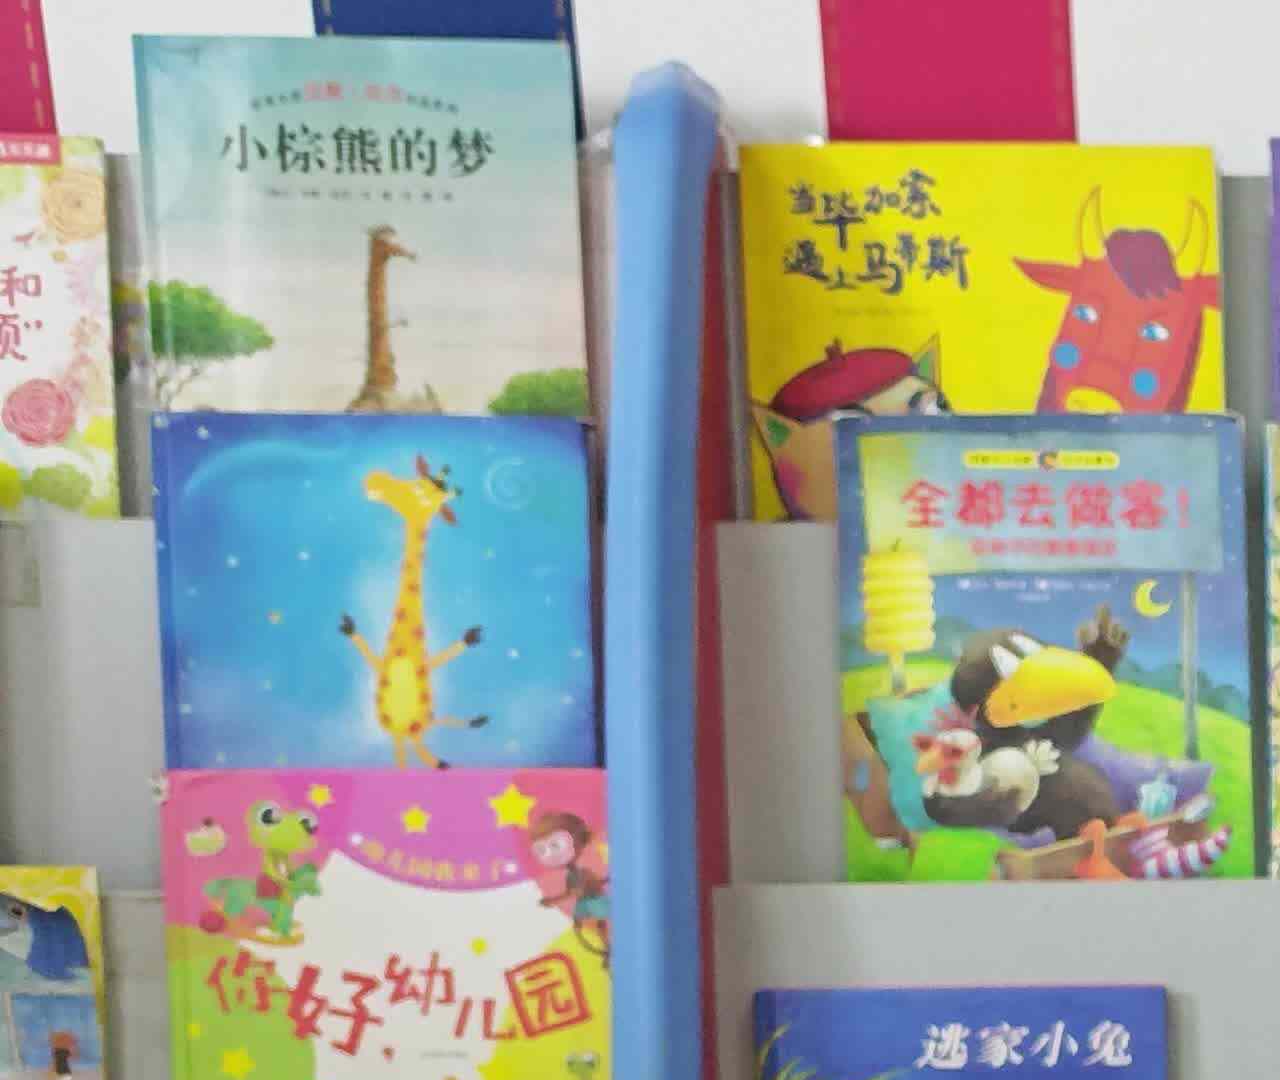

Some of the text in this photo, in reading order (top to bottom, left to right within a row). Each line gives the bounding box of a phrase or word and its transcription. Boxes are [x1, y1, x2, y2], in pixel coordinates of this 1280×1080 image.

[220, 122, 496, 179] 小棕熊的梦
[913, 1019, 1134, 1071] 逃家小兔
